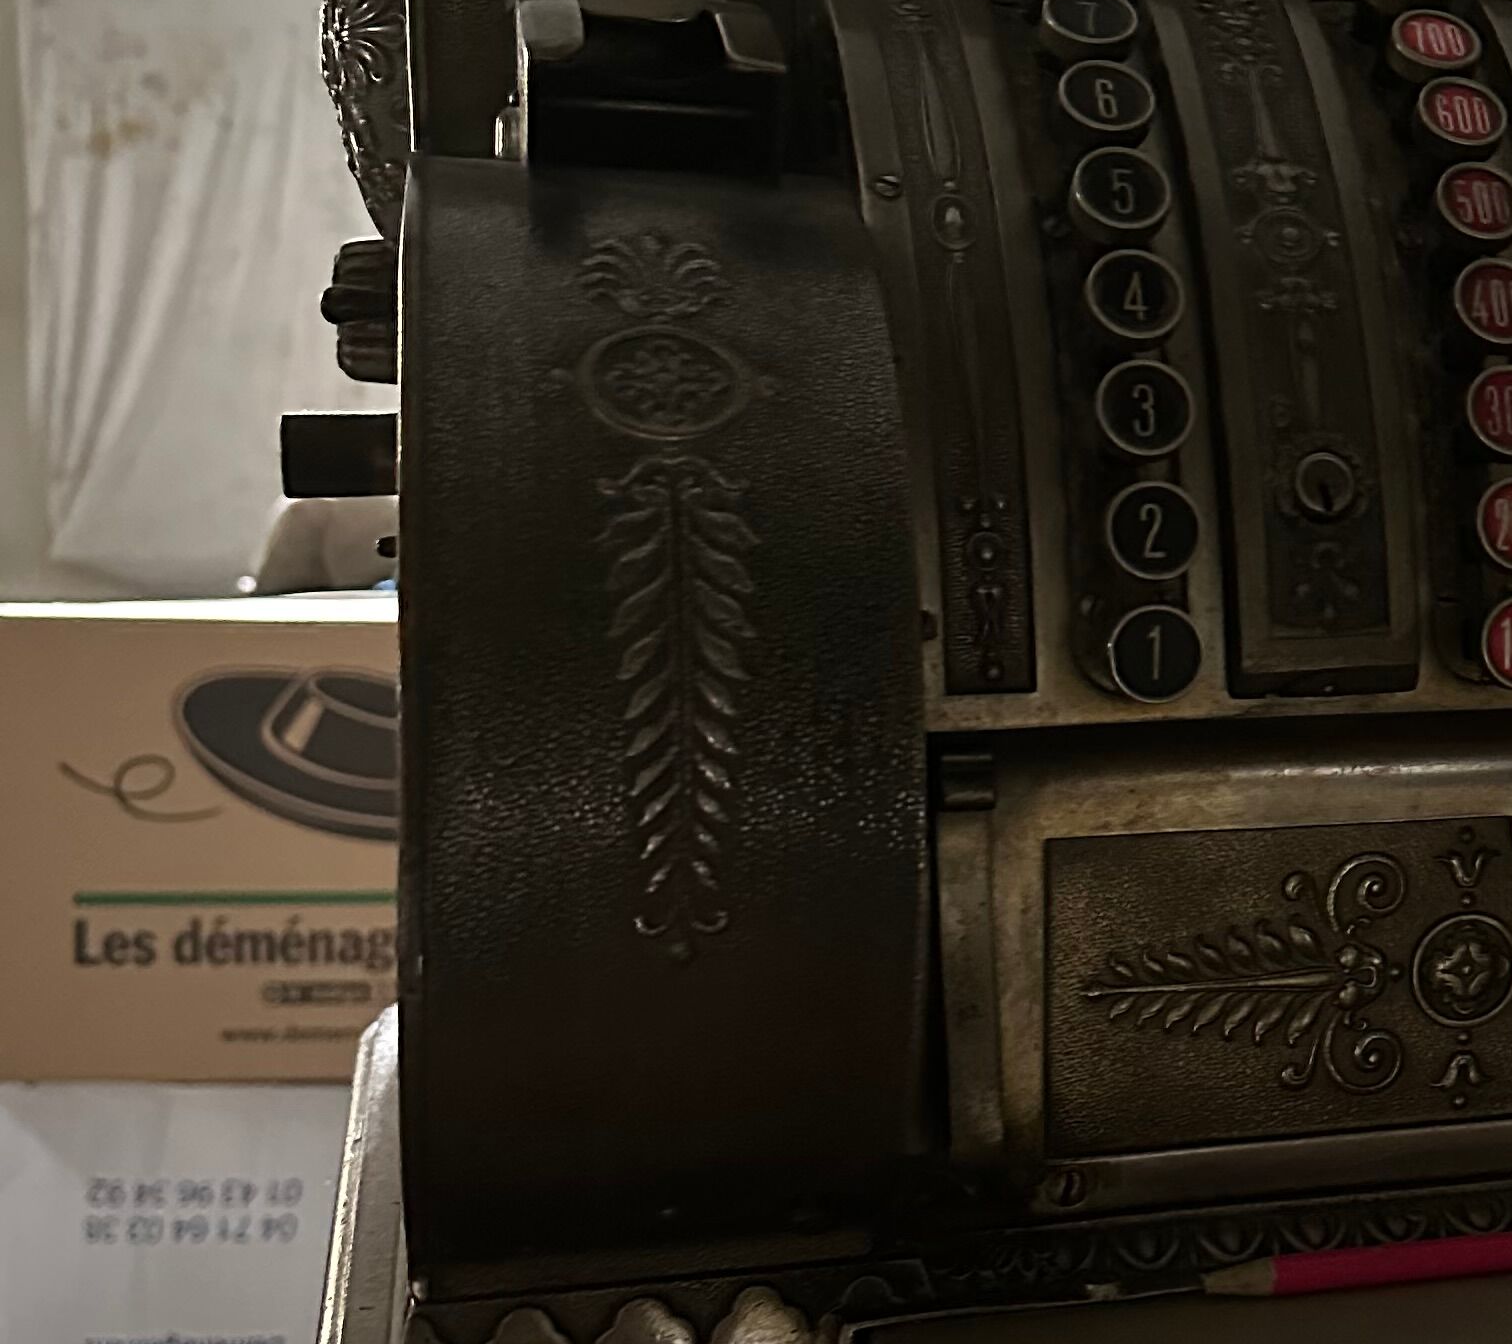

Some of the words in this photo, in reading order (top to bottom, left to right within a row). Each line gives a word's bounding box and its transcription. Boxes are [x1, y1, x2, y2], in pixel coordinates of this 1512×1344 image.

[1074, 1, 1099, 36] 7
[1404, 18, 1467, 58] 700
[1094, 77, 1119, 119] 6
[1433, 92, 1492, 135] 600
[1110, 168, 1136, 216] 5
[1452, 177, 1512, 226] 500
[1122, 270, 1151, 321] 4
[1131, 382, 1156, 437] 3
[1138, 502, 1167, 559] 2
[1145, 623, 1163, 682] 1
[73, 914, 158, 969] Les
